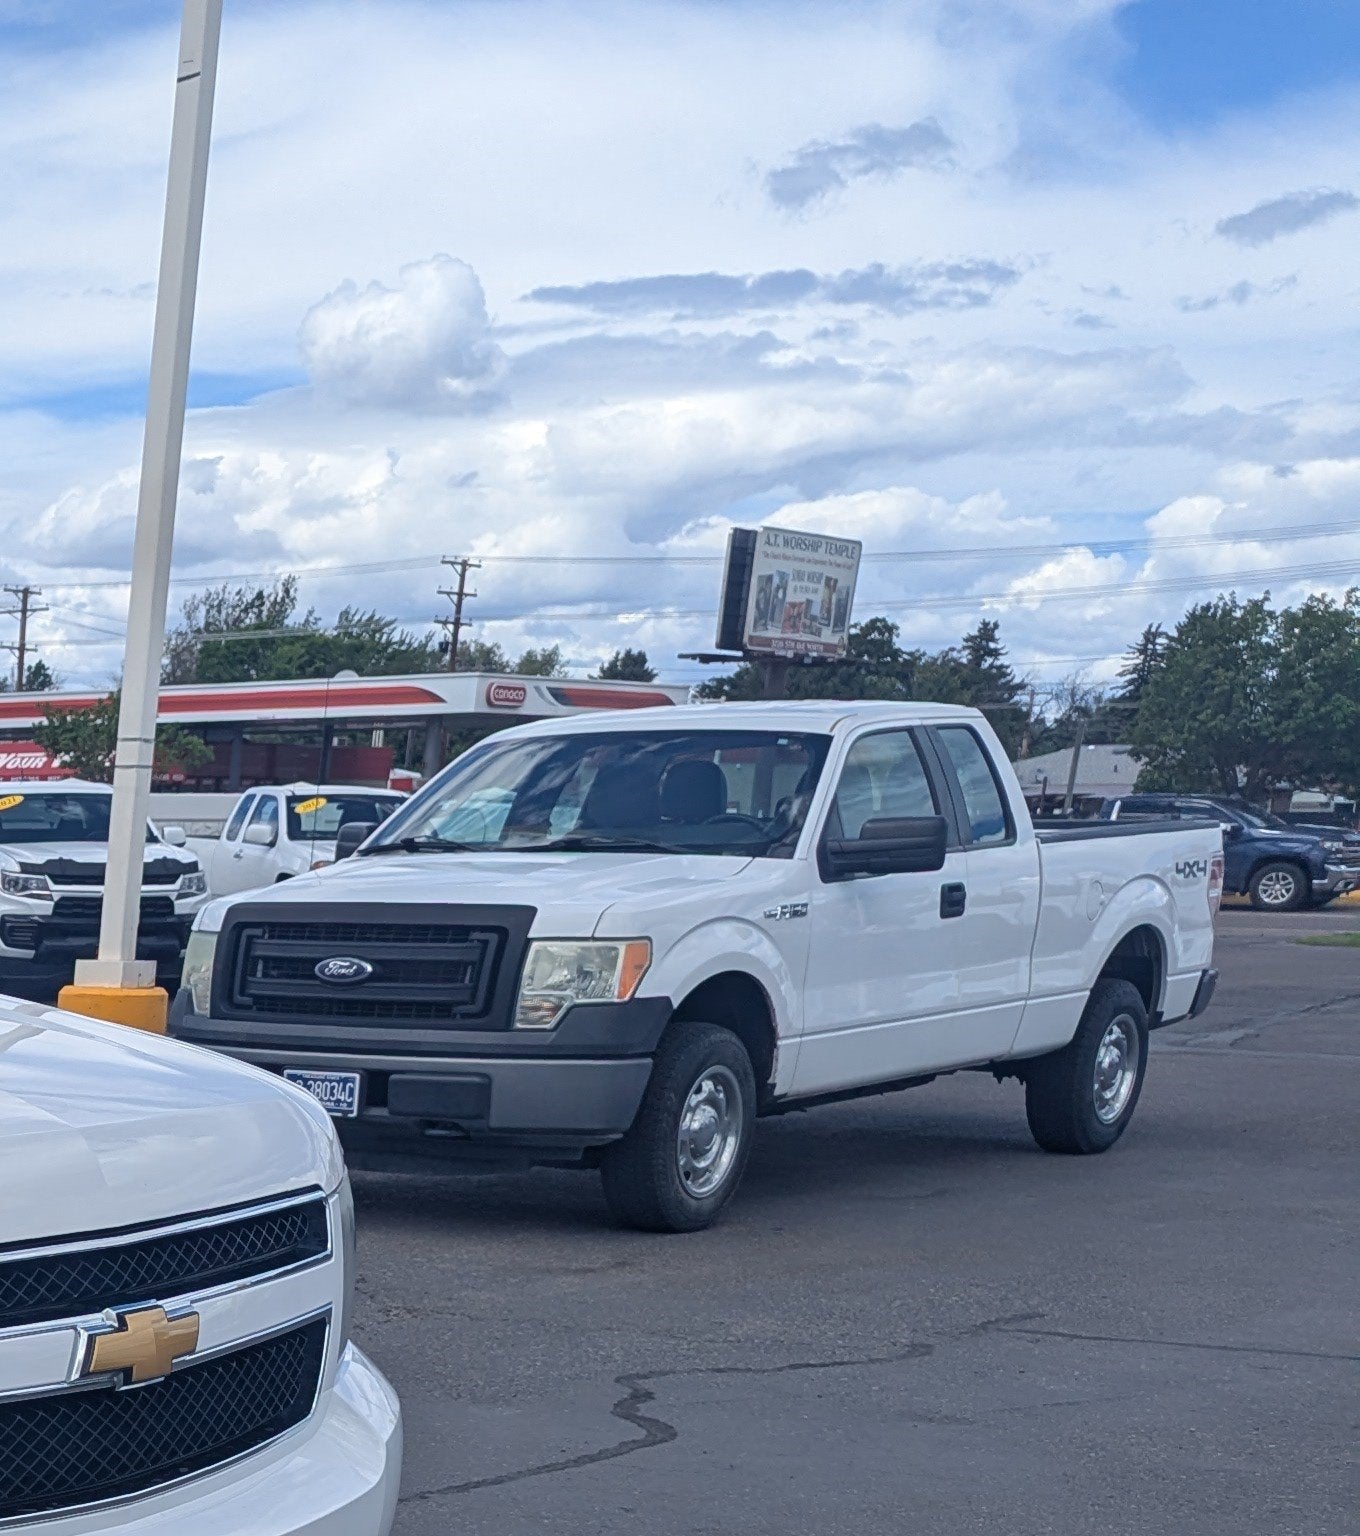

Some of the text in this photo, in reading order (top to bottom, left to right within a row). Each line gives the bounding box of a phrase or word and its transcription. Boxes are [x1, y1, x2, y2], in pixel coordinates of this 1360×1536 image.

[782, 535, 823, 553] WORSHIP
[824, 541, 856, 560] TEMPLE
[324, 960, 358, 976] Ford
